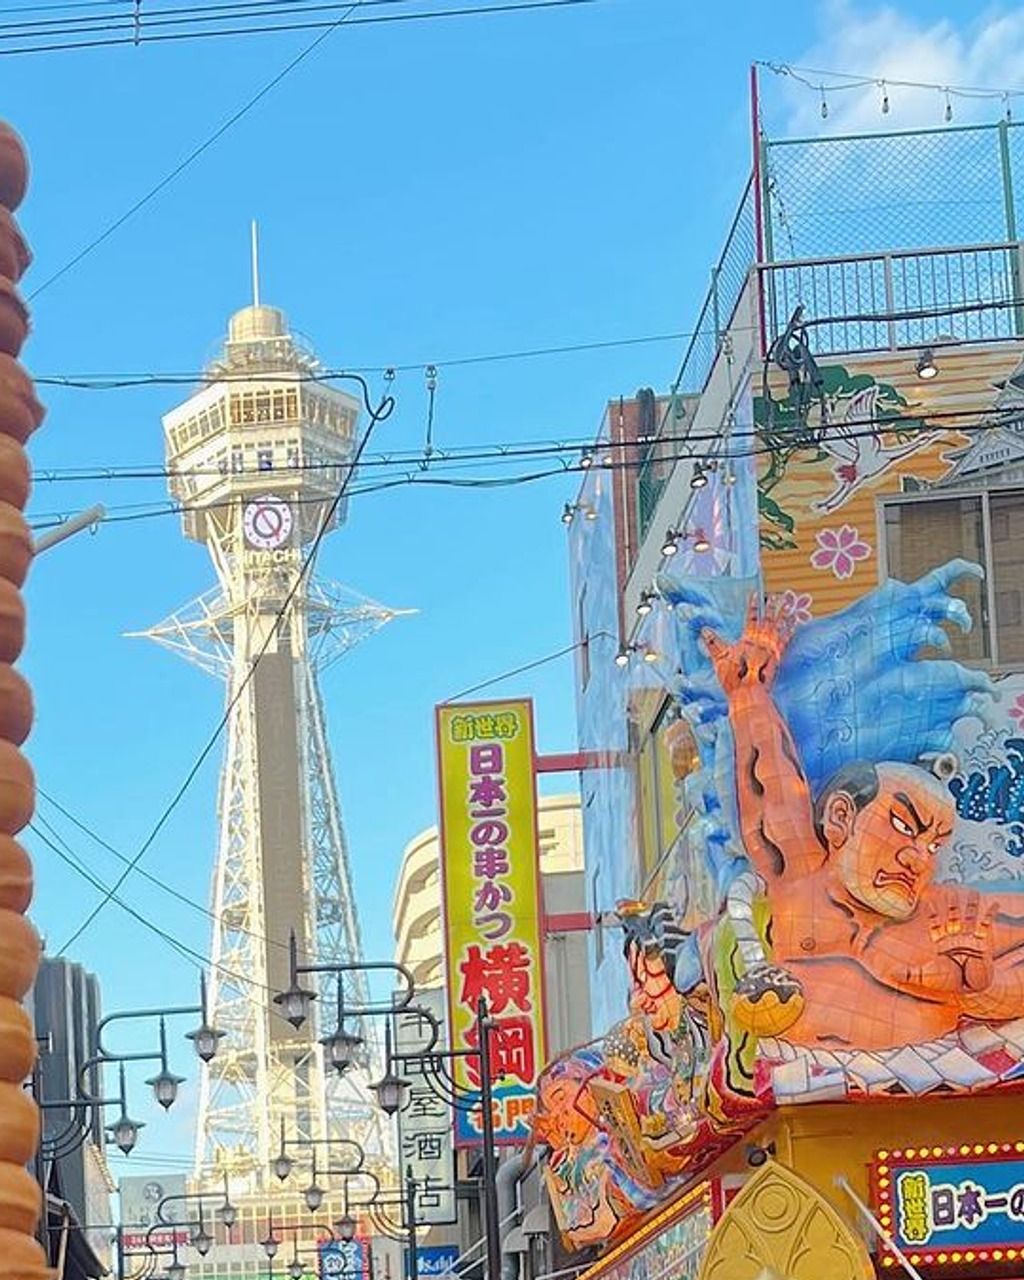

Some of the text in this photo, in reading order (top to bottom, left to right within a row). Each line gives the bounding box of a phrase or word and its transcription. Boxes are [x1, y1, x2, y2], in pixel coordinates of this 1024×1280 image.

[451, 714, 518, 742] 新世界
[467, 743, 513, 940] 日本一の串かつ
[459, 943, 533, 1090] 横綱
[901, 1174, 929, 1241] 新世界
